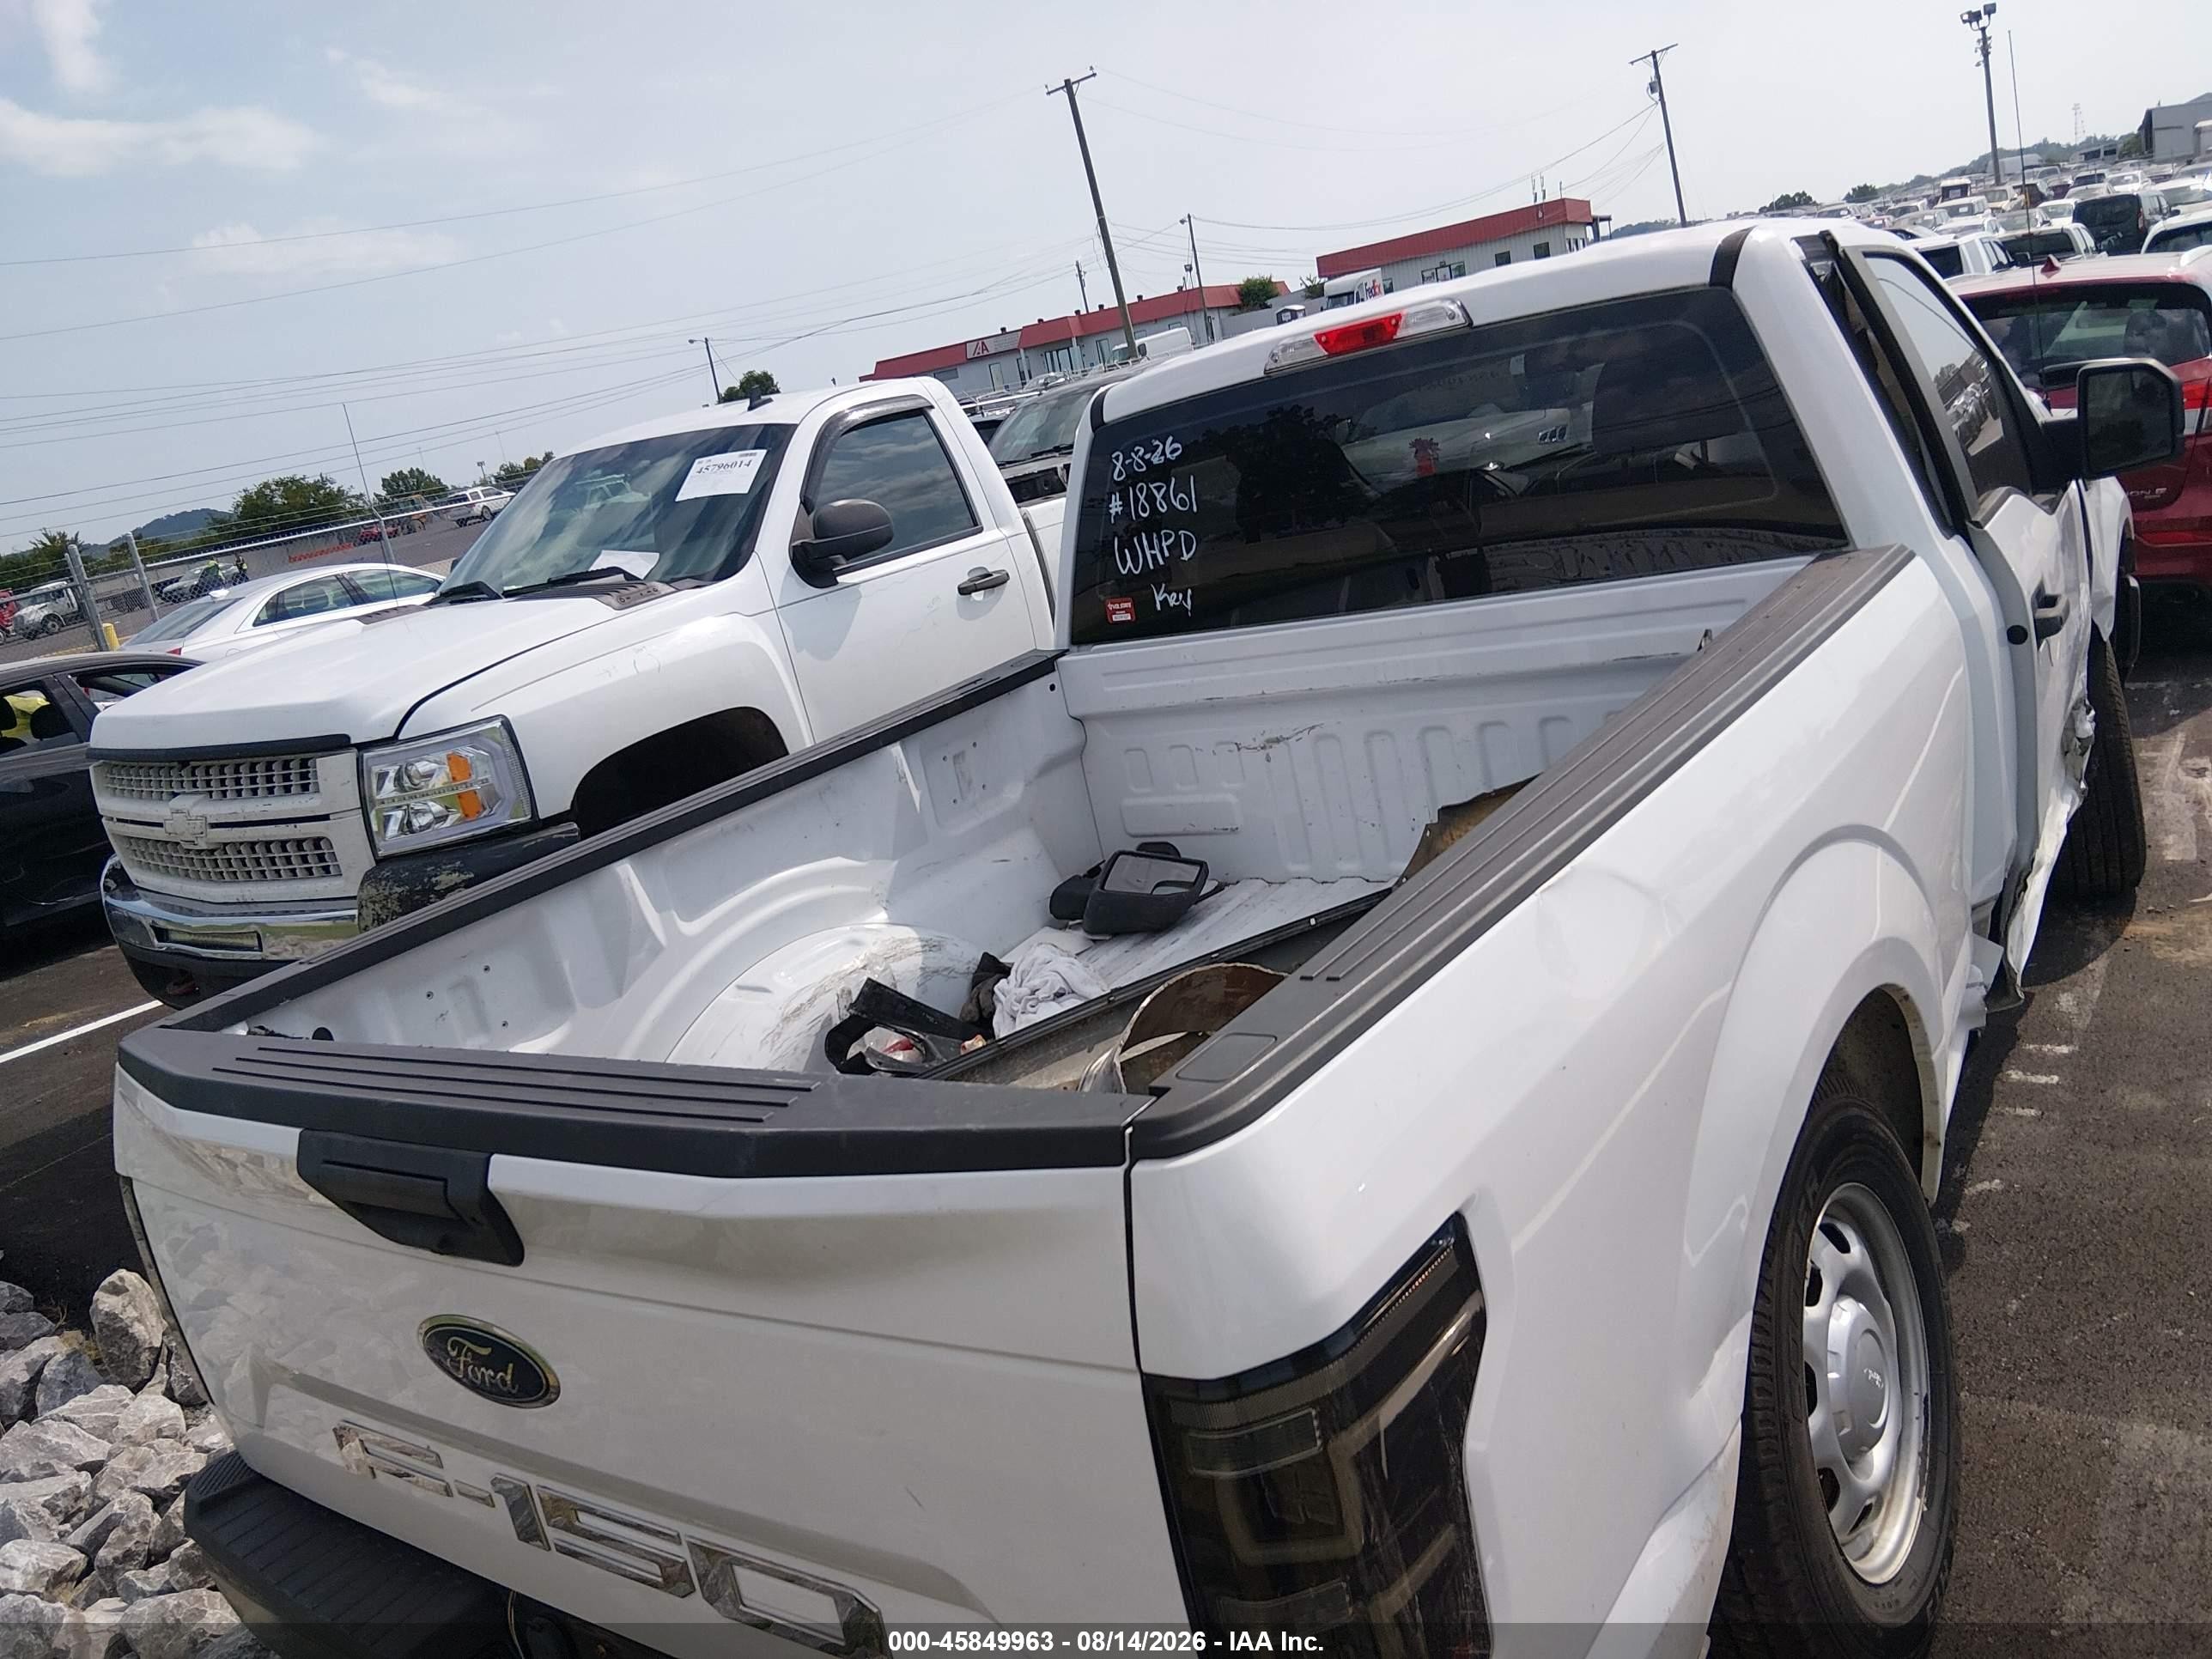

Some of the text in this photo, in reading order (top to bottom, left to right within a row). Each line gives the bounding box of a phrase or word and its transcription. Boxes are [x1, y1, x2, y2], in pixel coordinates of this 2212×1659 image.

[1112, 435, 1182, 481] 8-8-26
[1114, 529, 1197, 574] WHPD
[1151, 583, 1193, 617] Key
[447, 1336, 519, 1393] Ford
[332, 1419, 894, 1659] F-150
